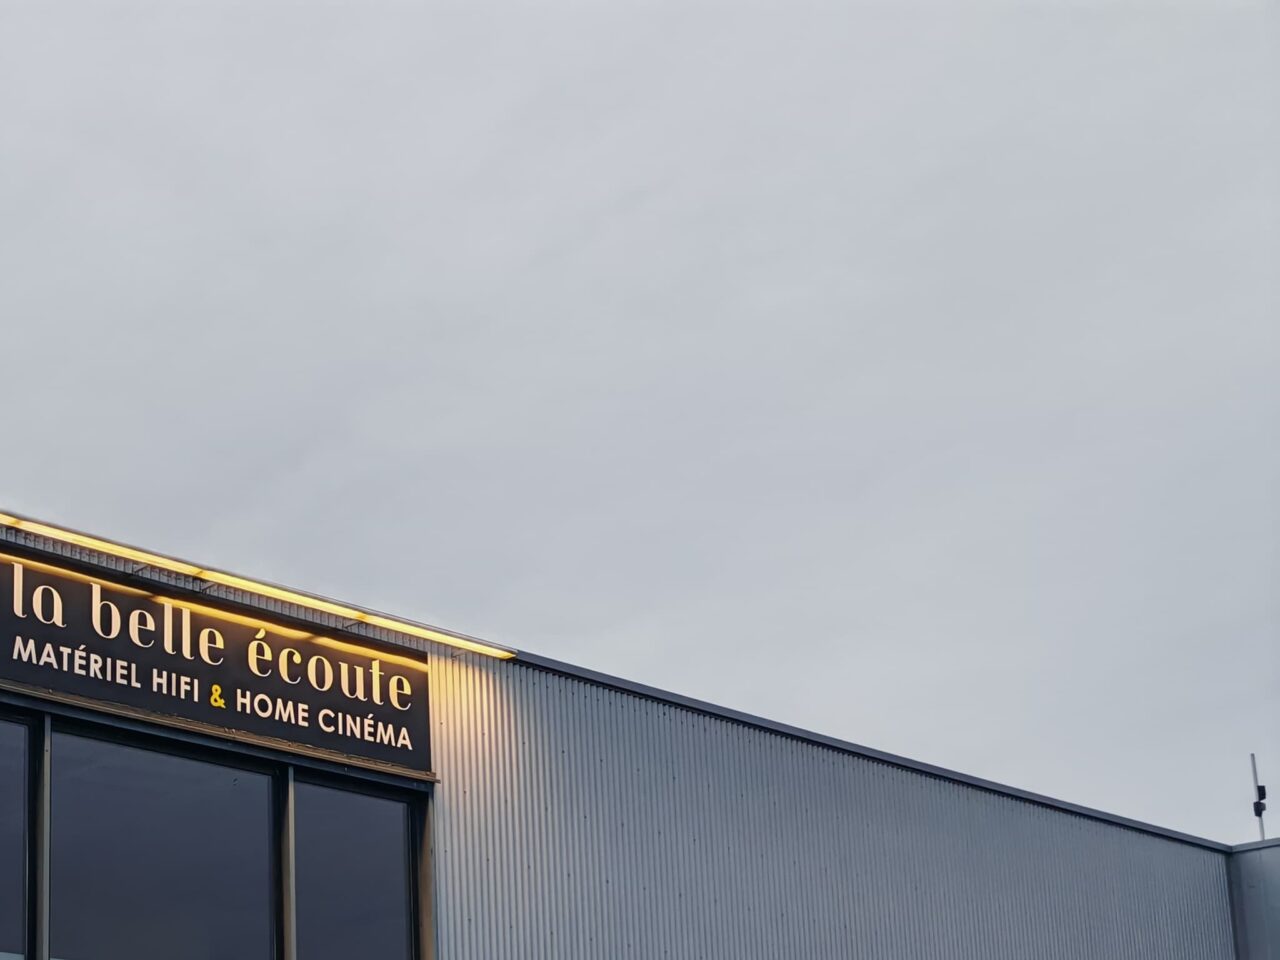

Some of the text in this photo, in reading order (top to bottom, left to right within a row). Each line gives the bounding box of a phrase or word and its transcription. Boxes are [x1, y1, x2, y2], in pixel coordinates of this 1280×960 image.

[11, 561, 67, 628] la
[90, 582, 225, 666] belle
[247, 627, 412, 711] écoute
[12, 635, 413, 751] MATÉRIEL HIFI & HOME CINÉMA
